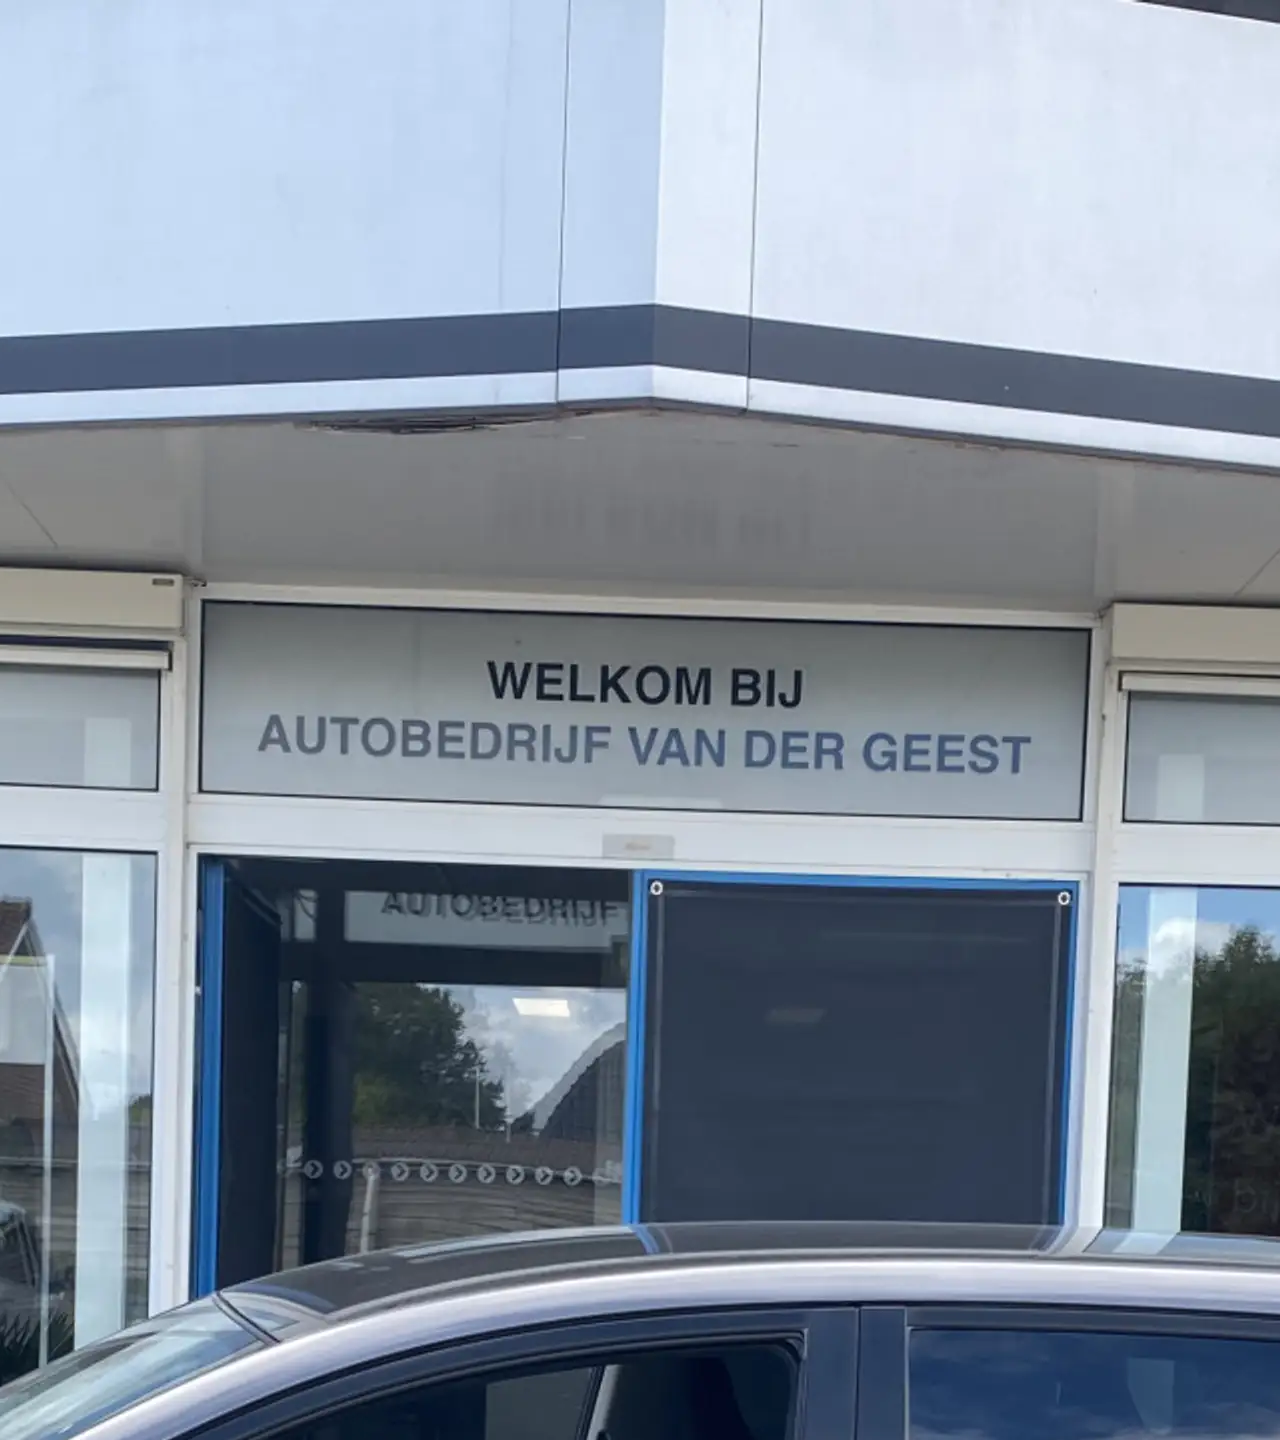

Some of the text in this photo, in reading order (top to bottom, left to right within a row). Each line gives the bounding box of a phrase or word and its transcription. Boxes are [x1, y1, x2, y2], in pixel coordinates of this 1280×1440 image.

[486, 660, 803, 708] WELKOM BIJ
[257, 713, 1032, 775] AUTOBEDRIJF VAN DER GEEST
[380, 892, 619, 925] AUTOBEDRIJF
